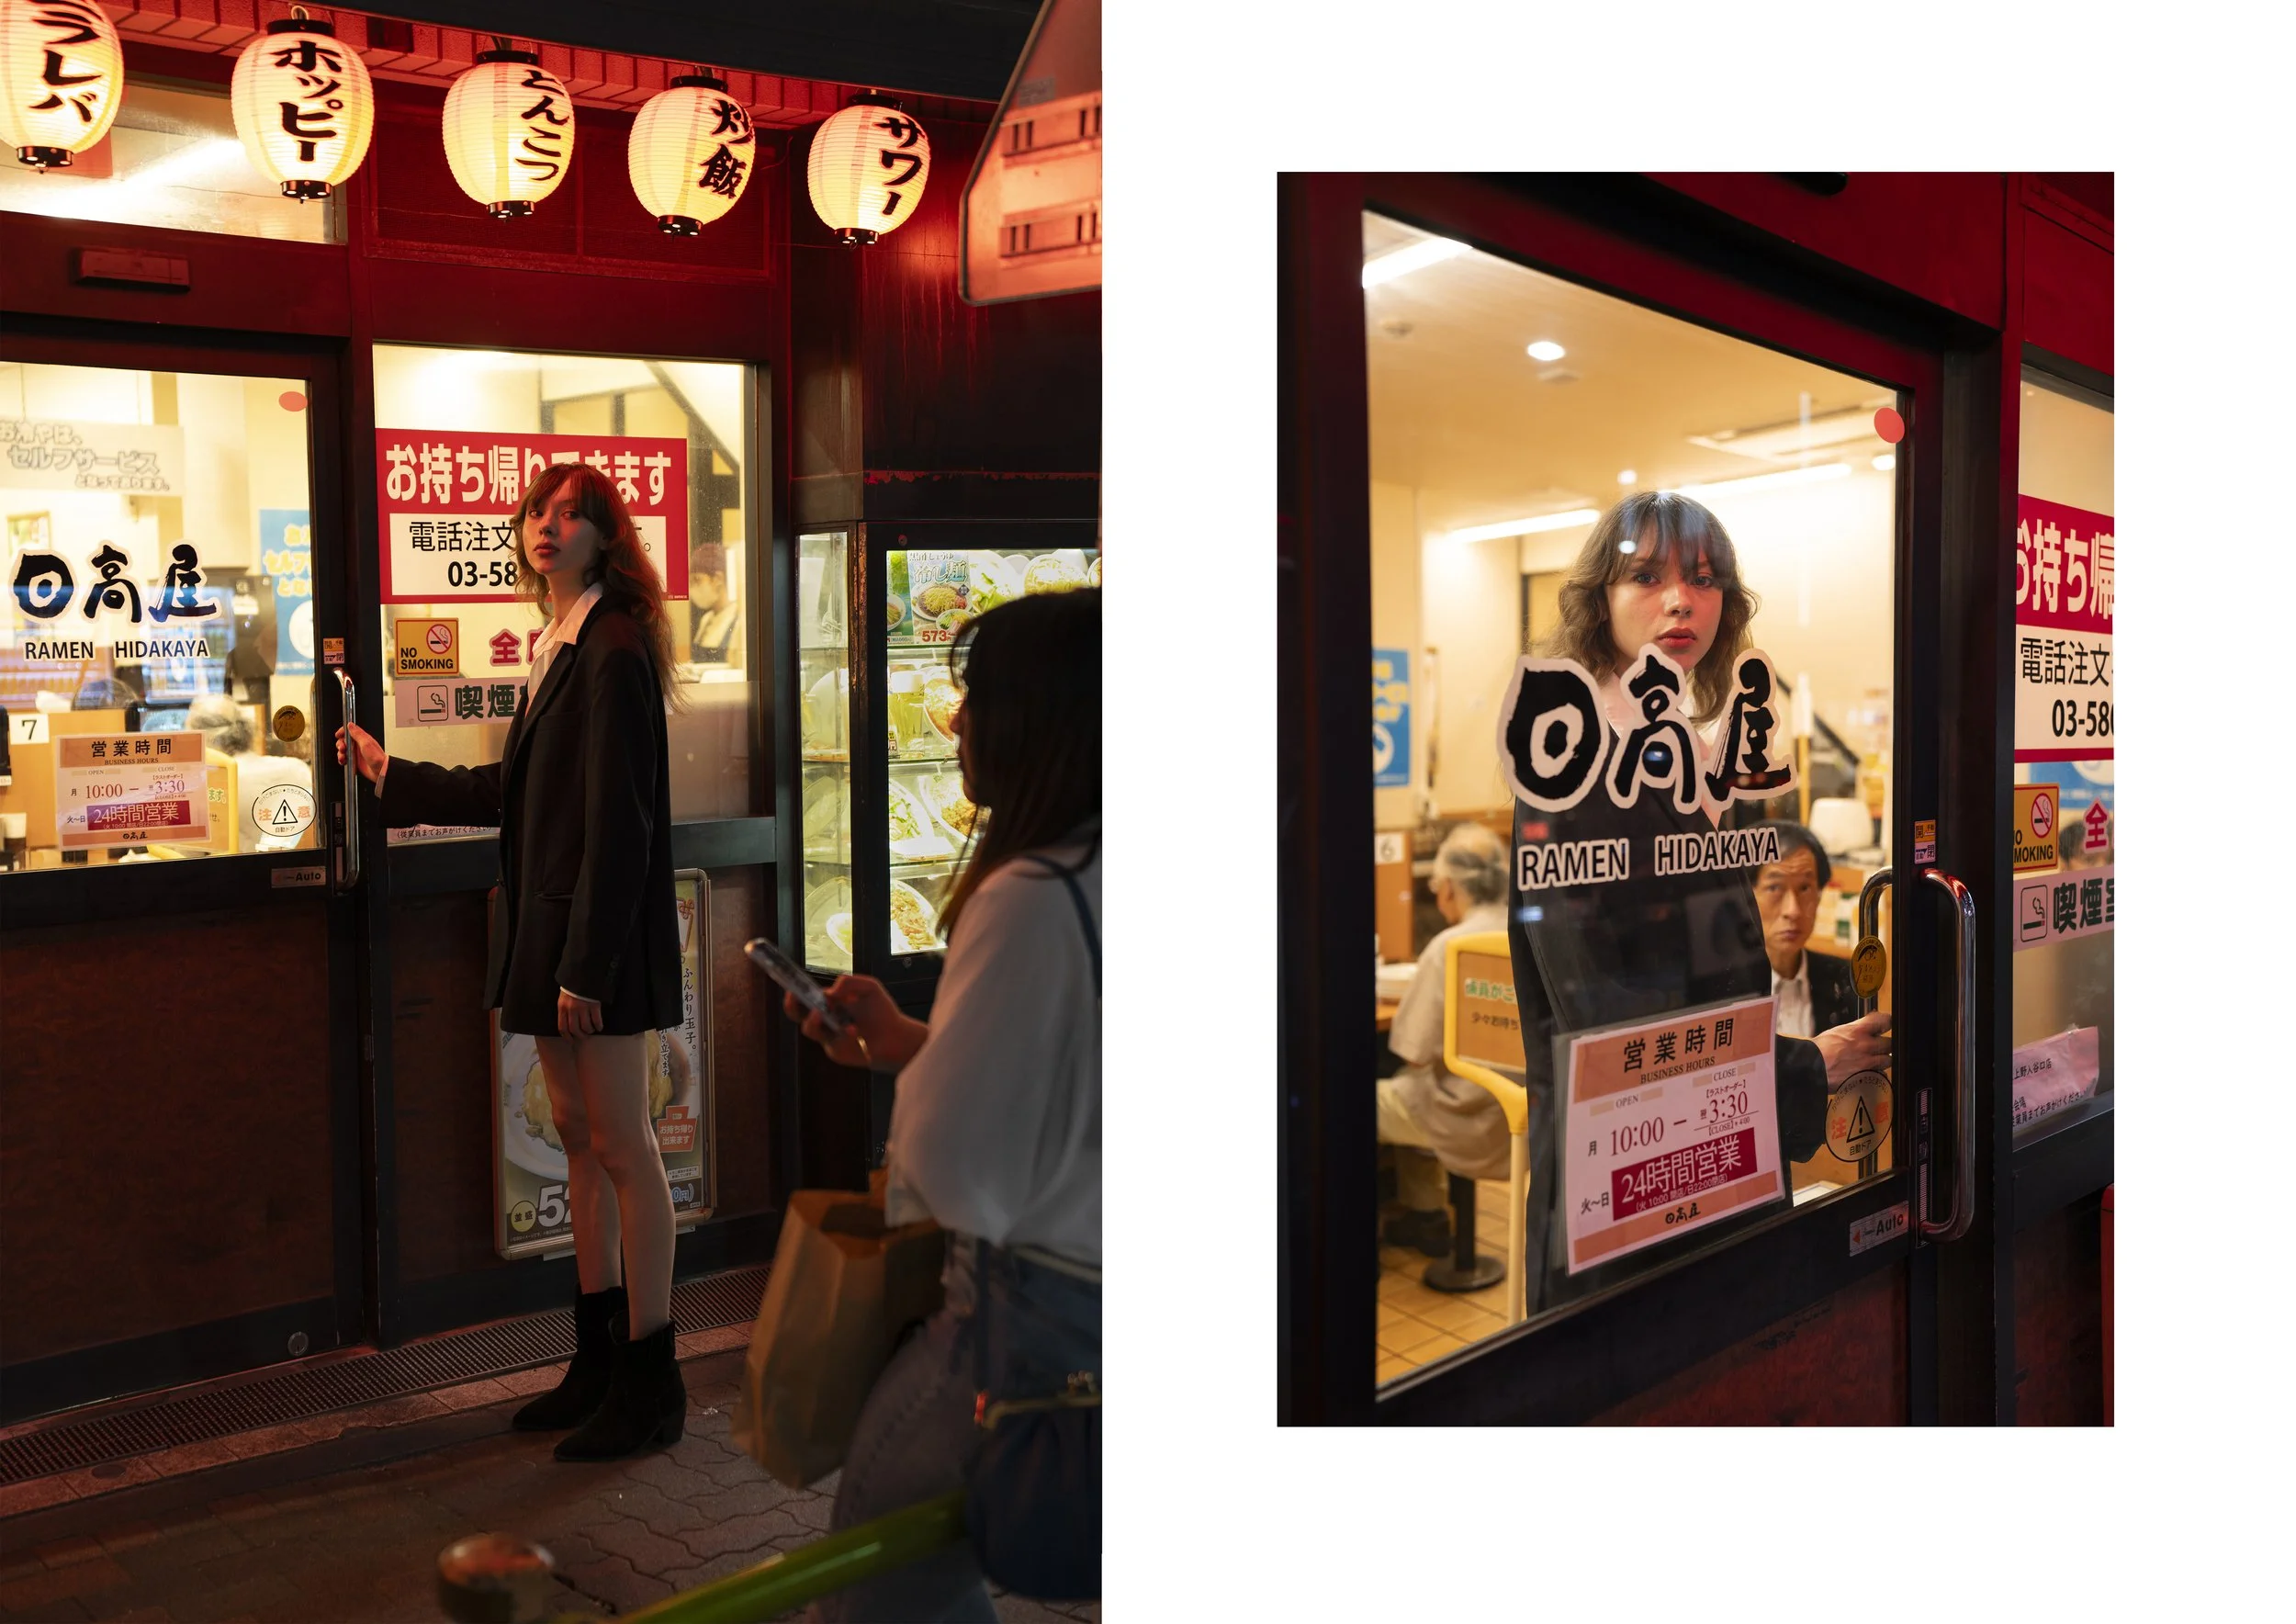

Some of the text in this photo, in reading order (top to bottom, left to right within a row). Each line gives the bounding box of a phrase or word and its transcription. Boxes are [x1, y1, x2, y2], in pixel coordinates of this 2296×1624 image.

[272, 40, 343, 162] ホッピー
[514, 69, 570, 182] とんこつ
[698, 98, 752, 199] 炒飯
[874, 117, 925, 216] サワー
[7, 445, 160, 476] セルフサービス
[386, 443, 671, 506] お持ち帰ります
[14, 544, 217, 623] 日高屋
[25, 640, 208, 659] RAMEN HIDAKAYA
[400, 647, 418, 658] NO
[400, 659, 454, 670] SMOKING
[455, 684, 526, 720] 喫煙
[21, 719, 38, 740] 7
[1504, 655, 1792, 803] 日高屋
[2052, 699, 2114, 738] 03-58
[91, 739, 172, 758] 営業時間
[71, 788, 77, 796] 月
[85, 784, 123, 799] 10:00
[155, 780, 185, 795] 3:30
[94, 802, 180, 824] 24時間営業
[258, 806, 310, 821] 注 意
[122, 831, 149, 840] 日高屋
[1916, 825, 1924, 839] 開
[1380, 840, 1395, 863] 6
[1523, 829, 1779, 885] RAMEN HIDAKAYA
[1927, 844, 1935, 859] 閉
[2013, 847, 2054, 863] MOKING
[296, 872, 321, 882] Auto
[1624, 1018, 1734, 1073] 営業時間
[1640, 1056, 1716, 1084] BUSINESS HOURS
[1714, 1067, 1737, 1081] CLOSE
[1616, 1095, 1639, 1108] OPEN
[659, 1124, 693, 1135] お持ち帰り
[1588, 1140, 1597, 1156] 月
[1611, 1116, 1664, 1156] 10:00
[1709, 1091, 1748, 1123] 3:30
[1831, 1117, 1847, 1140] 注
[662, 1135, 691, 1145] 出来ます
[1850, 1140, 1872, 1156] 自動ドア
[1621, 1134, 1741, 1203] 24時間営業
[1665, 1202, 1701, 1224] 日高屋
[1876, 1213, 1904, 1235] Auto
